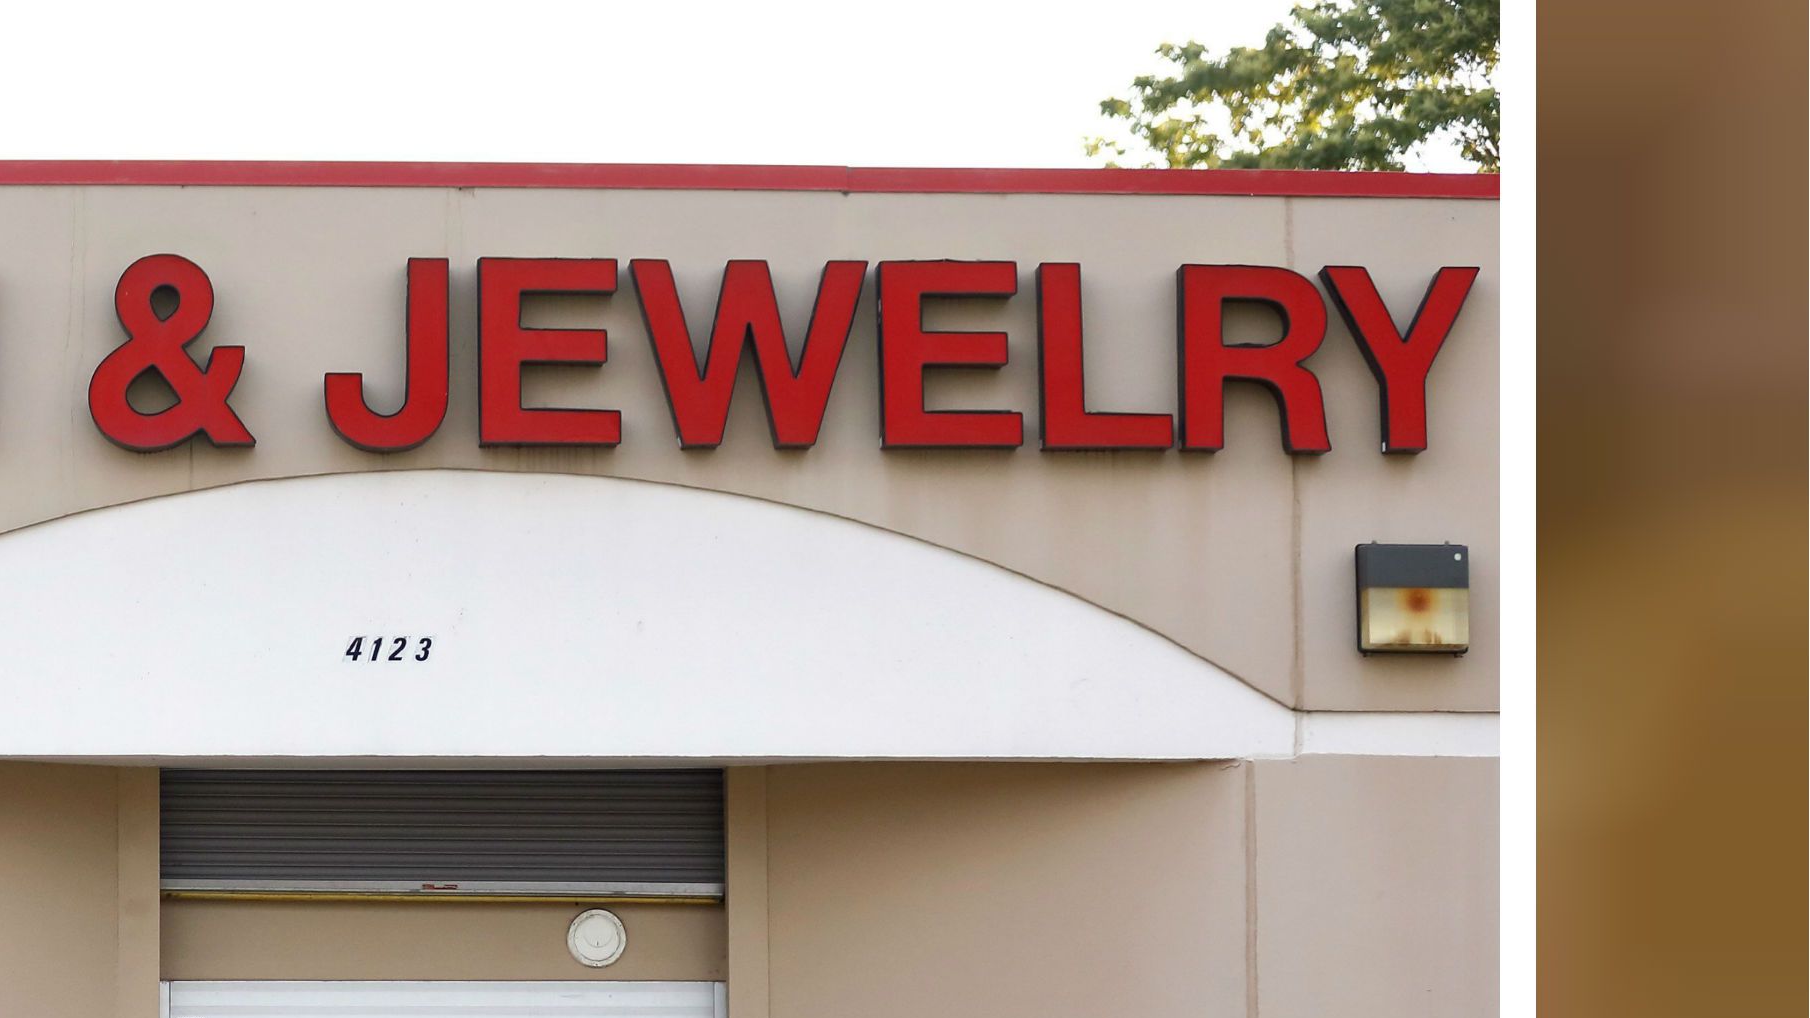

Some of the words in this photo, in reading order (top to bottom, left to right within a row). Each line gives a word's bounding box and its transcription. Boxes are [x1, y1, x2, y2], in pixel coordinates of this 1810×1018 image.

[88, 254, 256, 452] &
[323, 257, 1479, 454] JEWELRY
[345, 636, 433, 662] 4123
